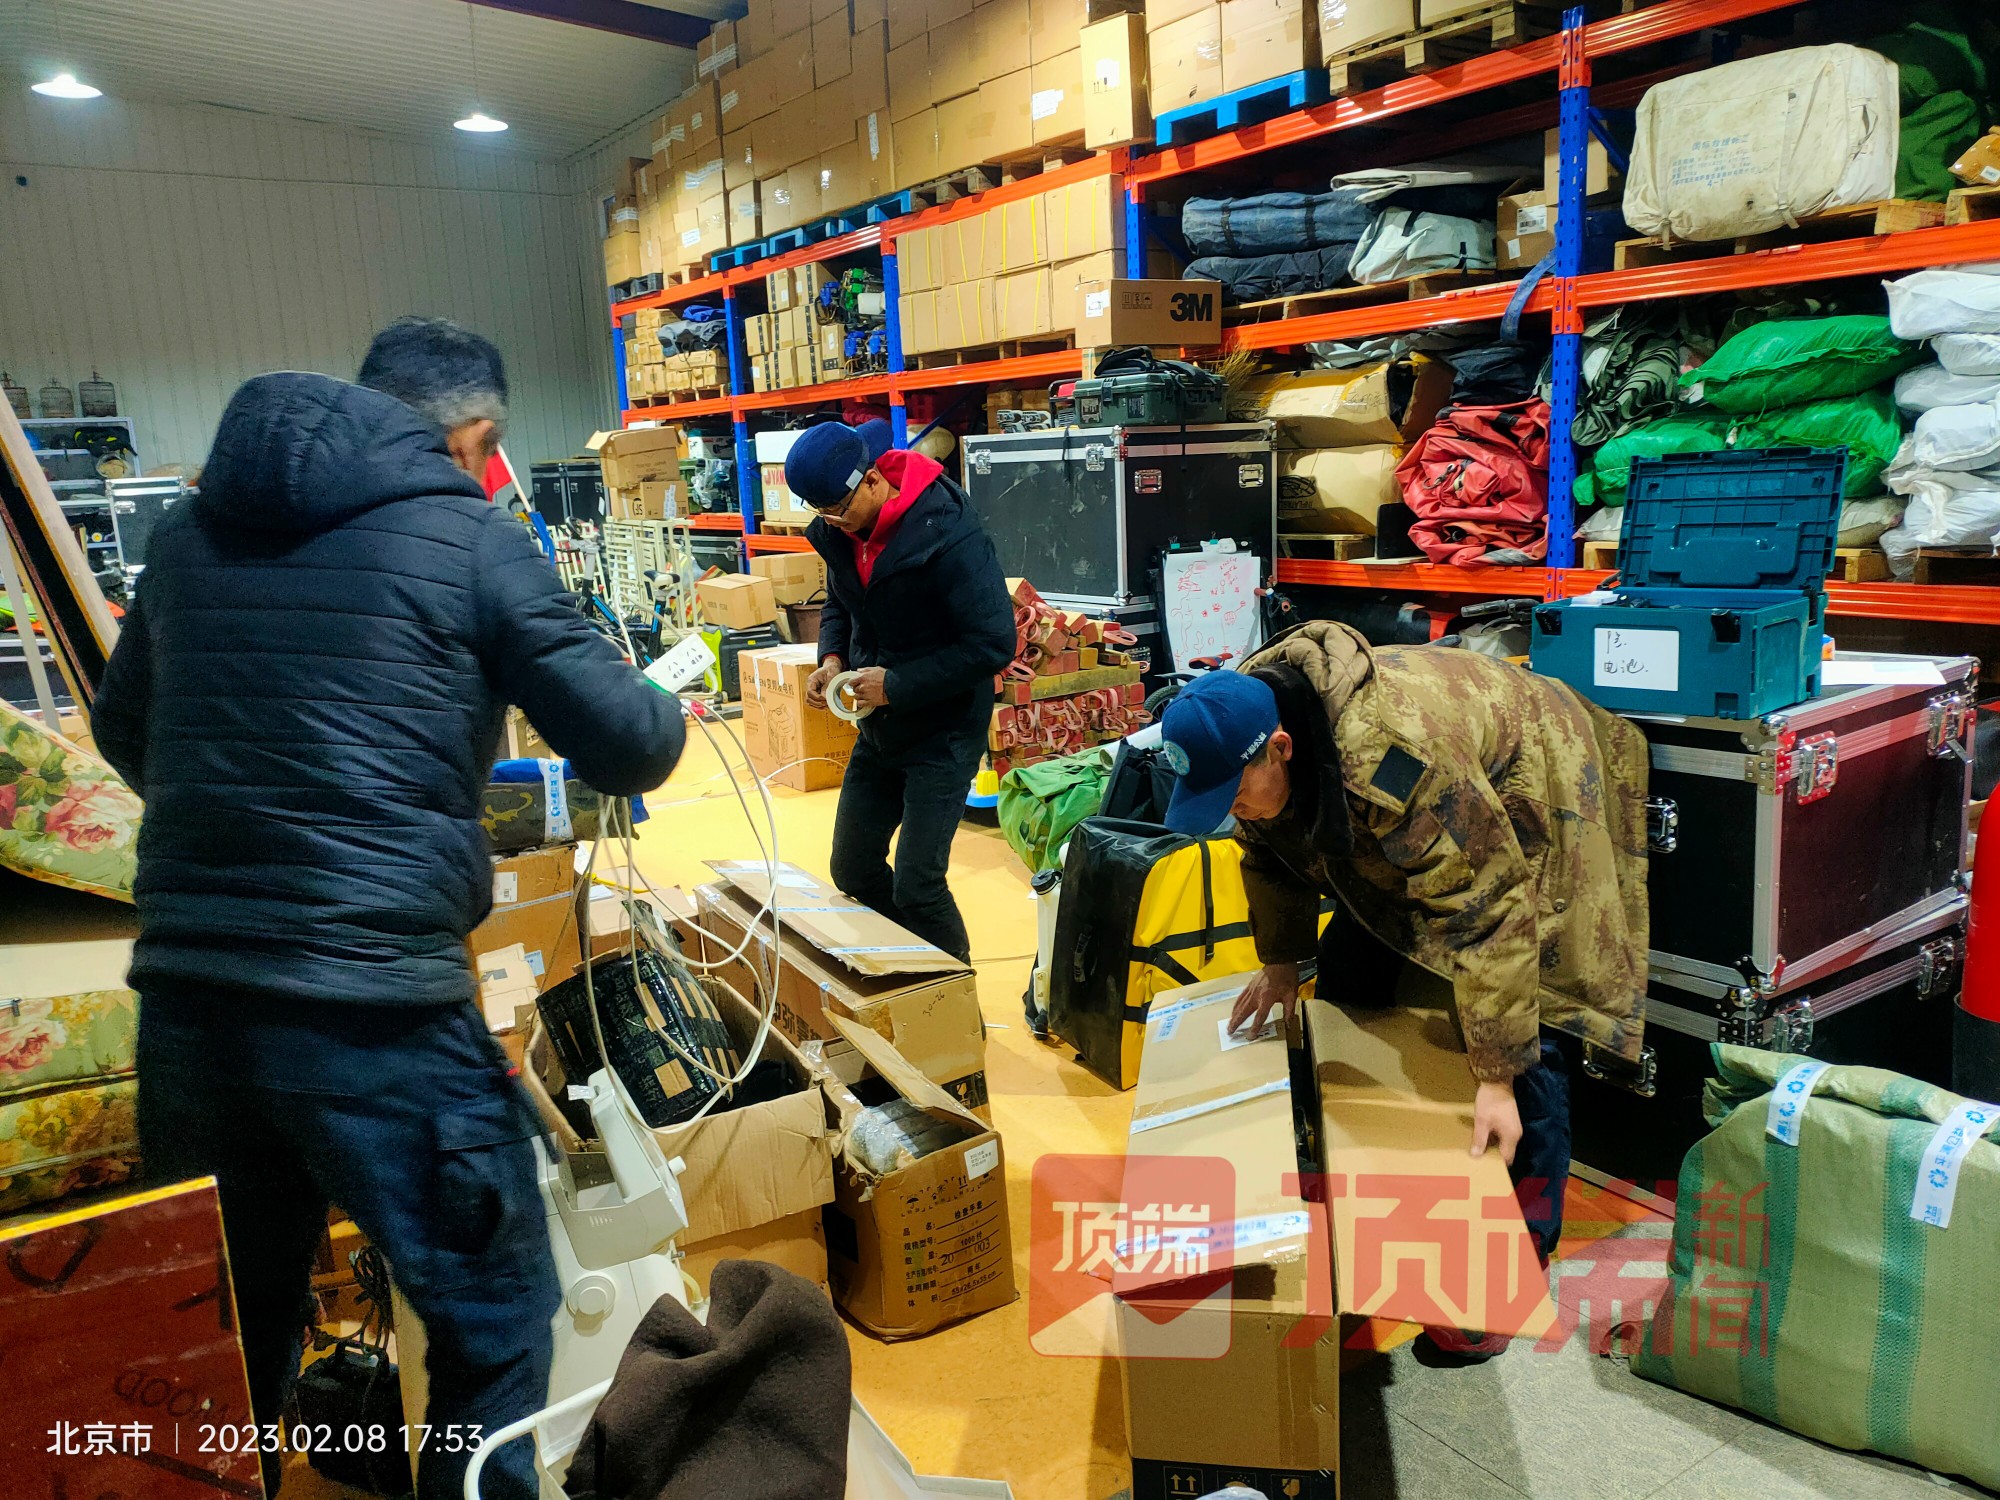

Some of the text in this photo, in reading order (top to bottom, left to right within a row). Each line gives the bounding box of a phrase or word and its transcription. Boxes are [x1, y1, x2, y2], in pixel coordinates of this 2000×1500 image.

[1170, 293, 1213, 322] 3M
[954, 1200, 983, 1220] 检查手套
